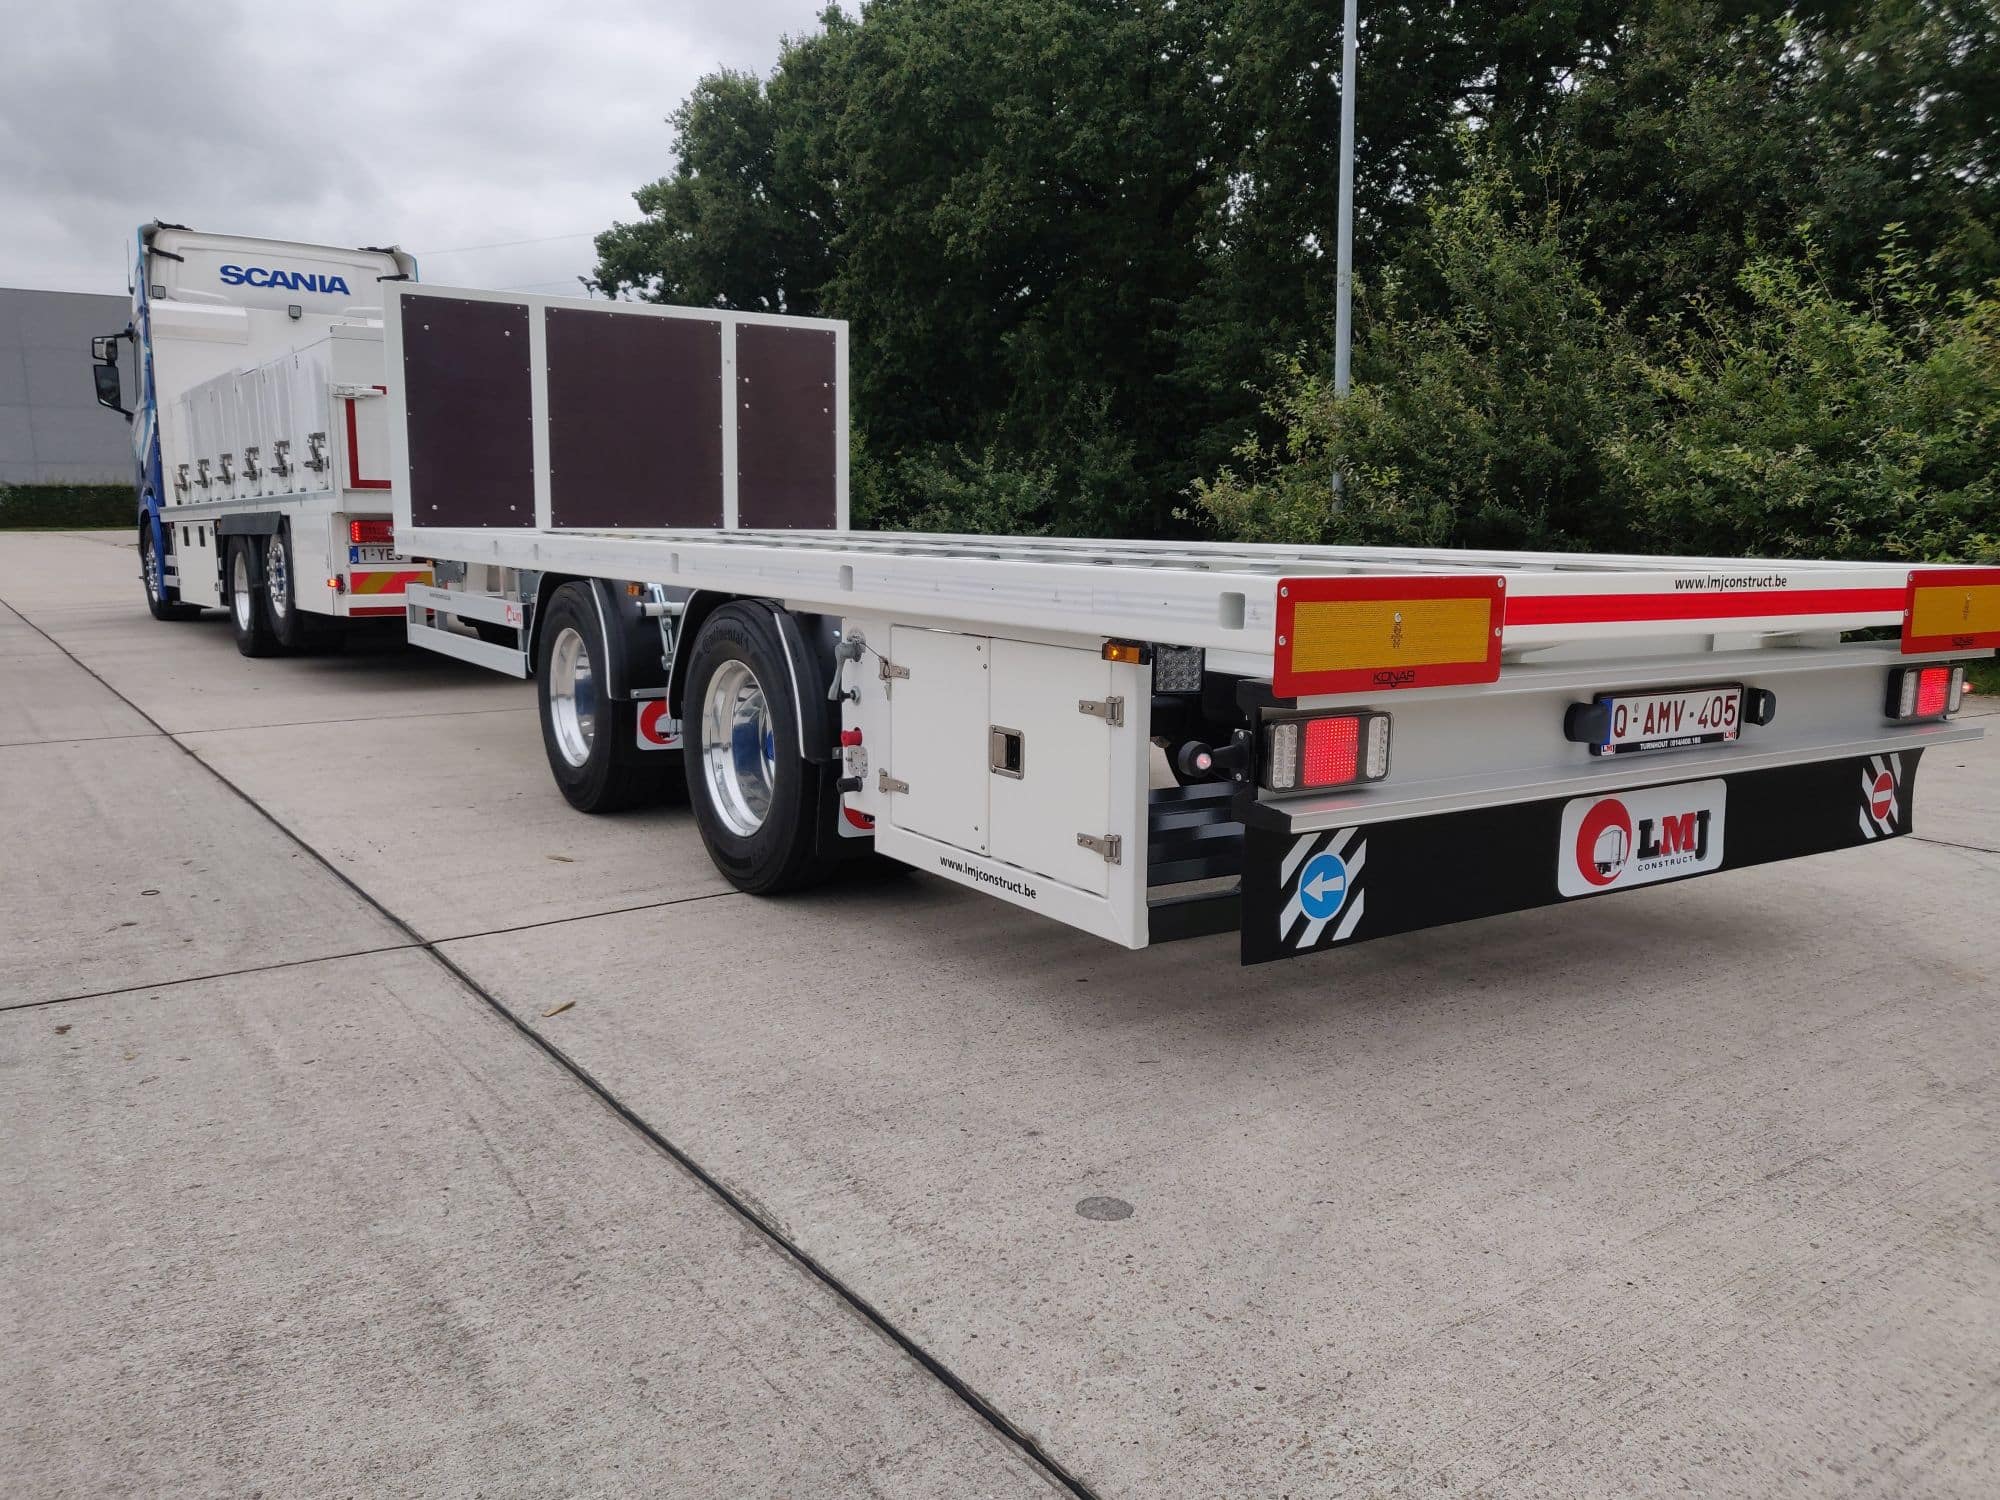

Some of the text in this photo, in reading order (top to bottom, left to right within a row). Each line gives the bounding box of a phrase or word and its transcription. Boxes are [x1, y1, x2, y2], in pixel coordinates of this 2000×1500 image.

[220, 265, 350, 295] SCANIA
[1674, 574, 1787, 591] www.lmjconstruct.be
[1637, 809, 1711, 861] LMJ
[940, 856, 1037, 899] www.lmjconstruct.be
[1637, 855, 1693, 872] CONSTRUCT
